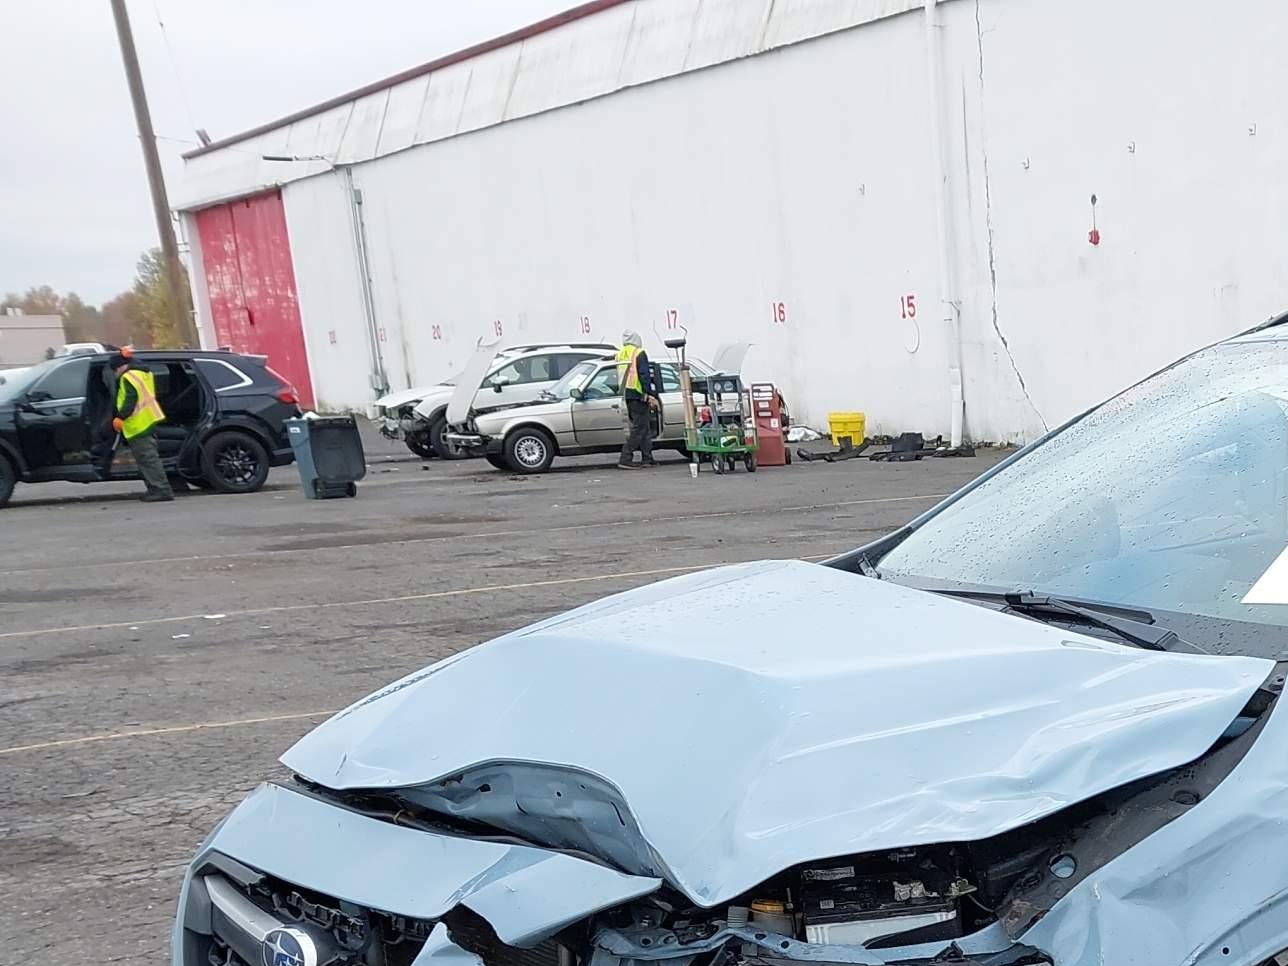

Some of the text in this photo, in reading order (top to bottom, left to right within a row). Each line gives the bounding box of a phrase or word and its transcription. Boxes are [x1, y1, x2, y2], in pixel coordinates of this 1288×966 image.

[772, 302, 786, 323] 16
[900, 295, 916, 319] 15
[493, 319, 503, 337] 19
[580, 316, 591, 334] 18
[666, 309, 678, 329] 17
[431, 324, 442, 340] 20
